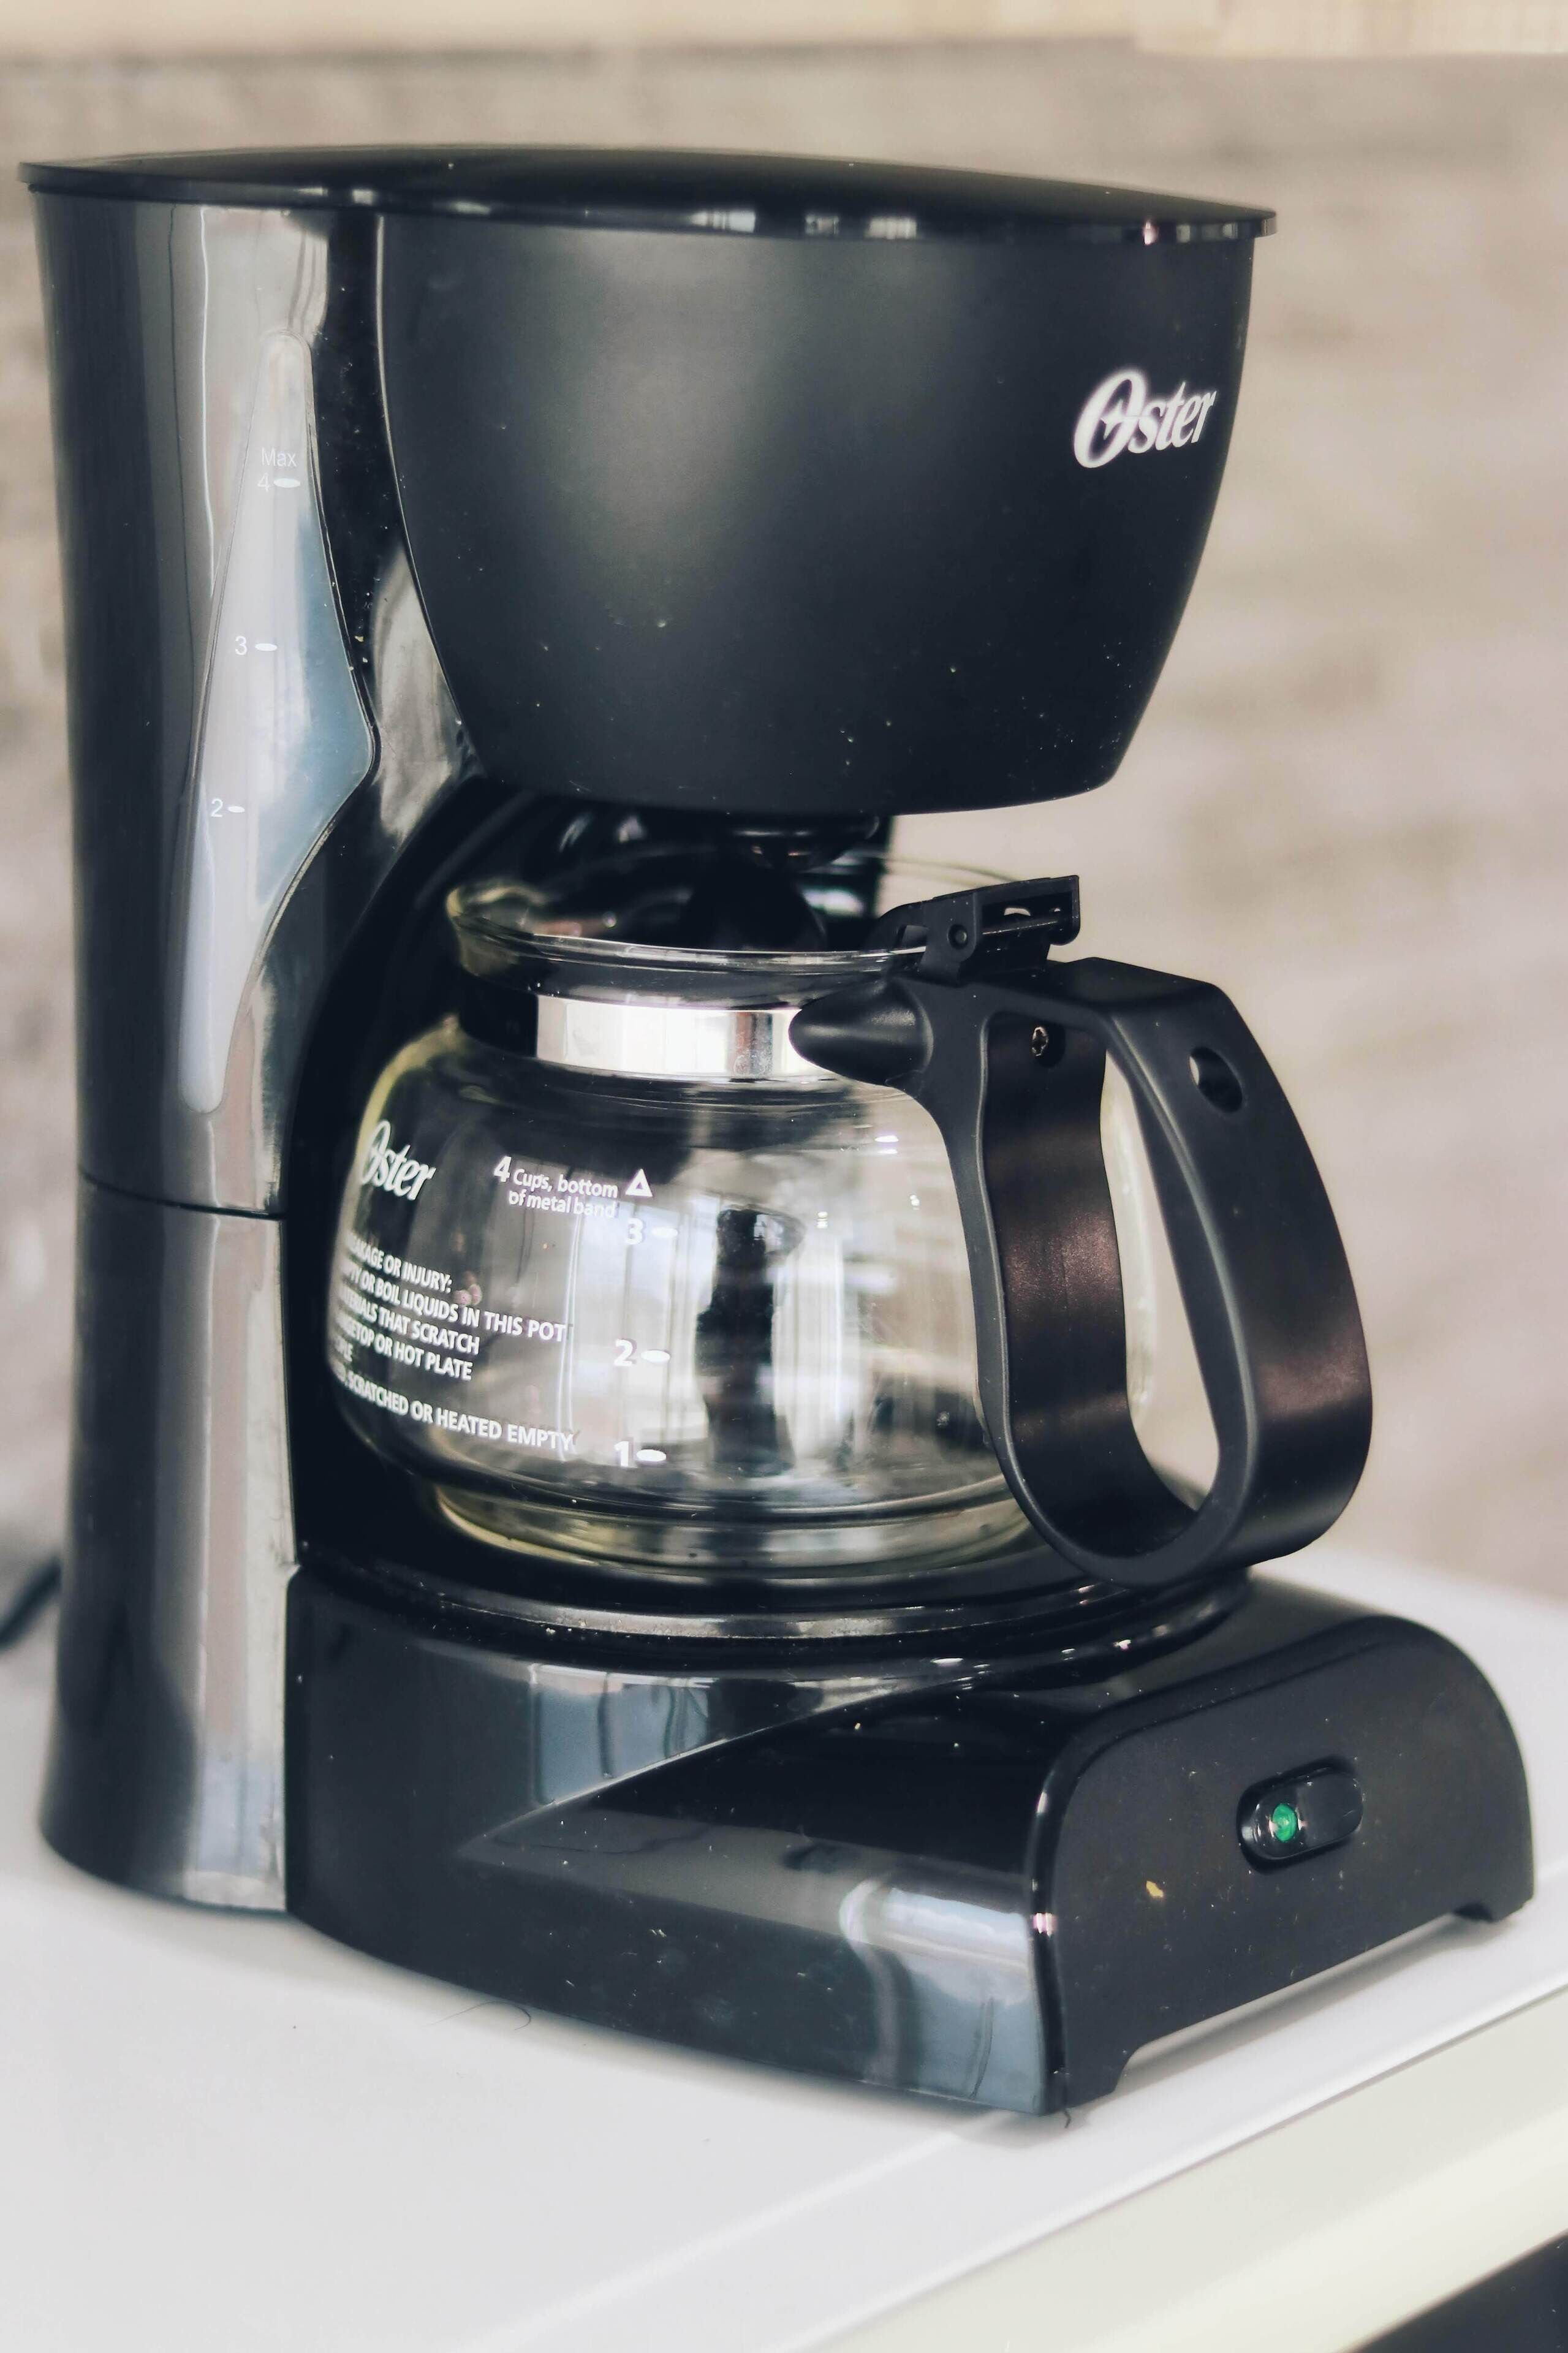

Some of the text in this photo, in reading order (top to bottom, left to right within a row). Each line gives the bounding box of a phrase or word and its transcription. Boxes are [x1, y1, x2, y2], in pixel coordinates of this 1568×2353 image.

[1074, 368, 1217, 468] Oster
[261, 447, 297, 467] Max
[257, 472, 270, 493] 4
[235, 635, 248, 656] 3
[211, 798, 223, 818] 2
[360, 1120, 437, 1201] Oster
[494, 1156, 618, 1199] 4 Cups, bottom
[508, 1189, 617, 1218] of metal band
[626, 1217, 643, 1245] 3
[383, 1254, 402, 1278] OR
[401, 1261, 453, 1294] INJURY:
[360, 1270, 376, 1294] OR
[375, 1277, 401, 1306] BOIL
[401, 1289, 460, 1322] LIQUIDS
[461, 1306, 480, 1328] IN
[484, 1311, 523, 1336] THIS
[527, 1319, 566, 1343] POT
[379, 1306, 412, 1335] THAT
[411, 1320, 480, 1355] SCRATCH
[373, 1333, 393, 1357] OR
[393, 1341, 425, 1368] HOT
[425, 1351, 474, 1382] PLATE
[614, 1338, 634, 1367] 2
[347, 1370, 574, 1452] SCRATCHED OR HEATED EMPTY
[613, 1441, 629, 1467] 1
